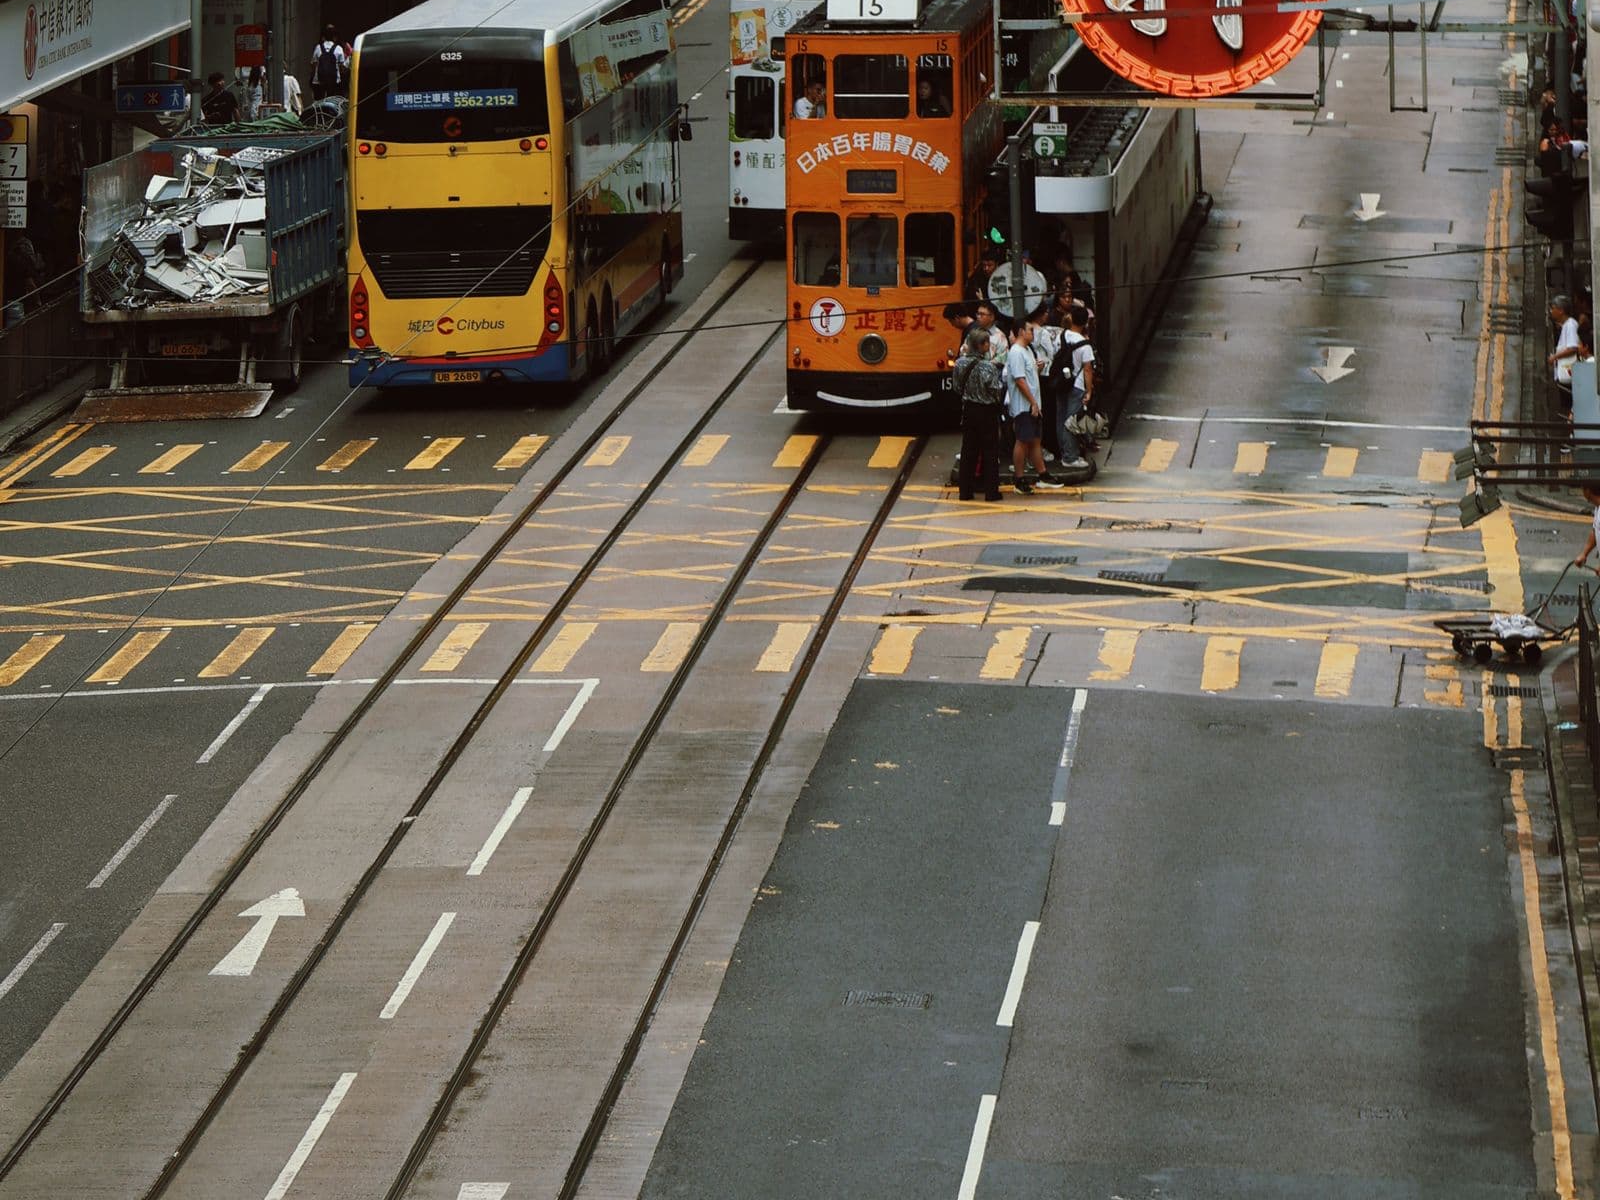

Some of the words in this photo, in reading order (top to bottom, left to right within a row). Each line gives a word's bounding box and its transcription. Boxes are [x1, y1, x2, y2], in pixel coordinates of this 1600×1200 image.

[797, 40, 808, 51] 15
[936, 39, 948, 51] 15
[440, 52, 463, 61] 6325
[395, 92, 451, 105] 招聘巴士車長
[454, 96, 484, 108] 5562
[486, 94, 515, 106] 2152
[9, 146, 18, 158] 7
[9, 165, 18, 177] 7
[407, 319, 435, 333] 城巴
[456, 318, 505, 332] Citybus
[854, 308, 935, 332] 正露丸
[437, 372, 450, 382] UB
[453, 372, 479, 382] 2689
